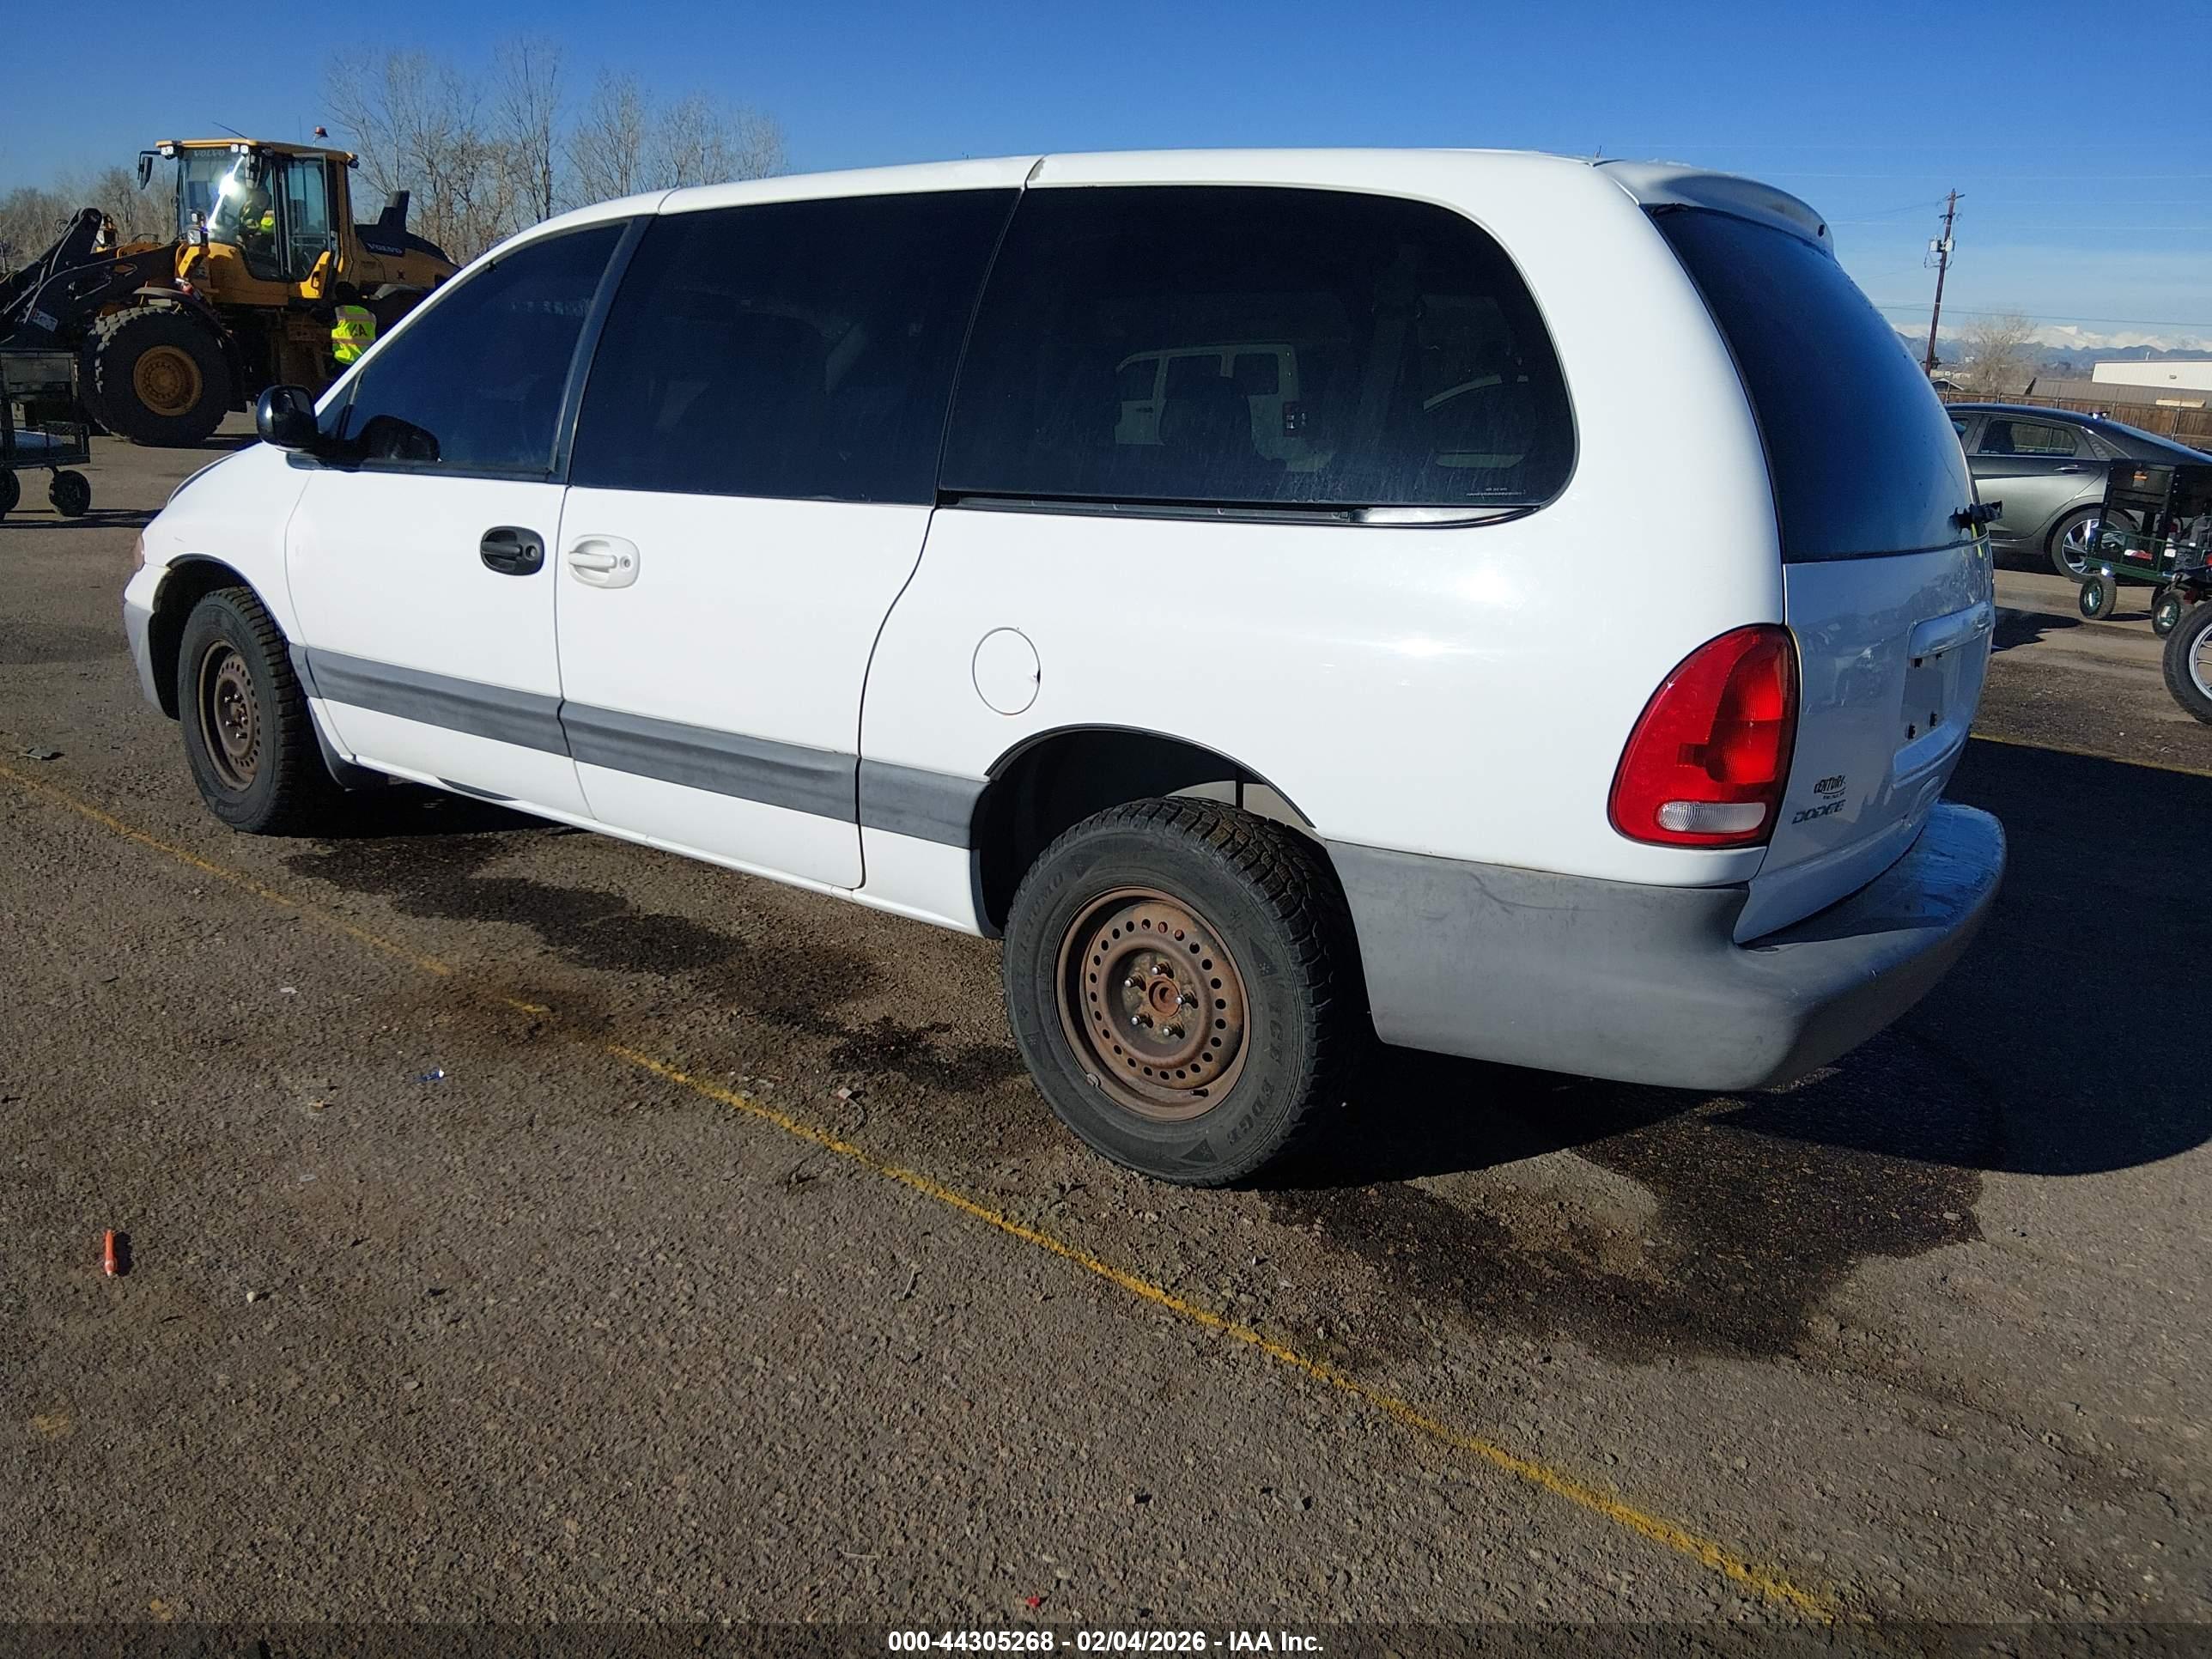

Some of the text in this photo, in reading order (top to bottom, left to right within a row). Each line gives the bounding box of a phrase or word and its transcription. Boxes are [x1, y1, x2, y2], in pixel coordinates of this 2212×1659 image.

[193, 149, 226, 158] VOLVO
[367, 242, 404, 254] VOLVO
[1791, 799, 1847, 825] DODGE
[1226, 1076, 1276, 1146] EDGE
